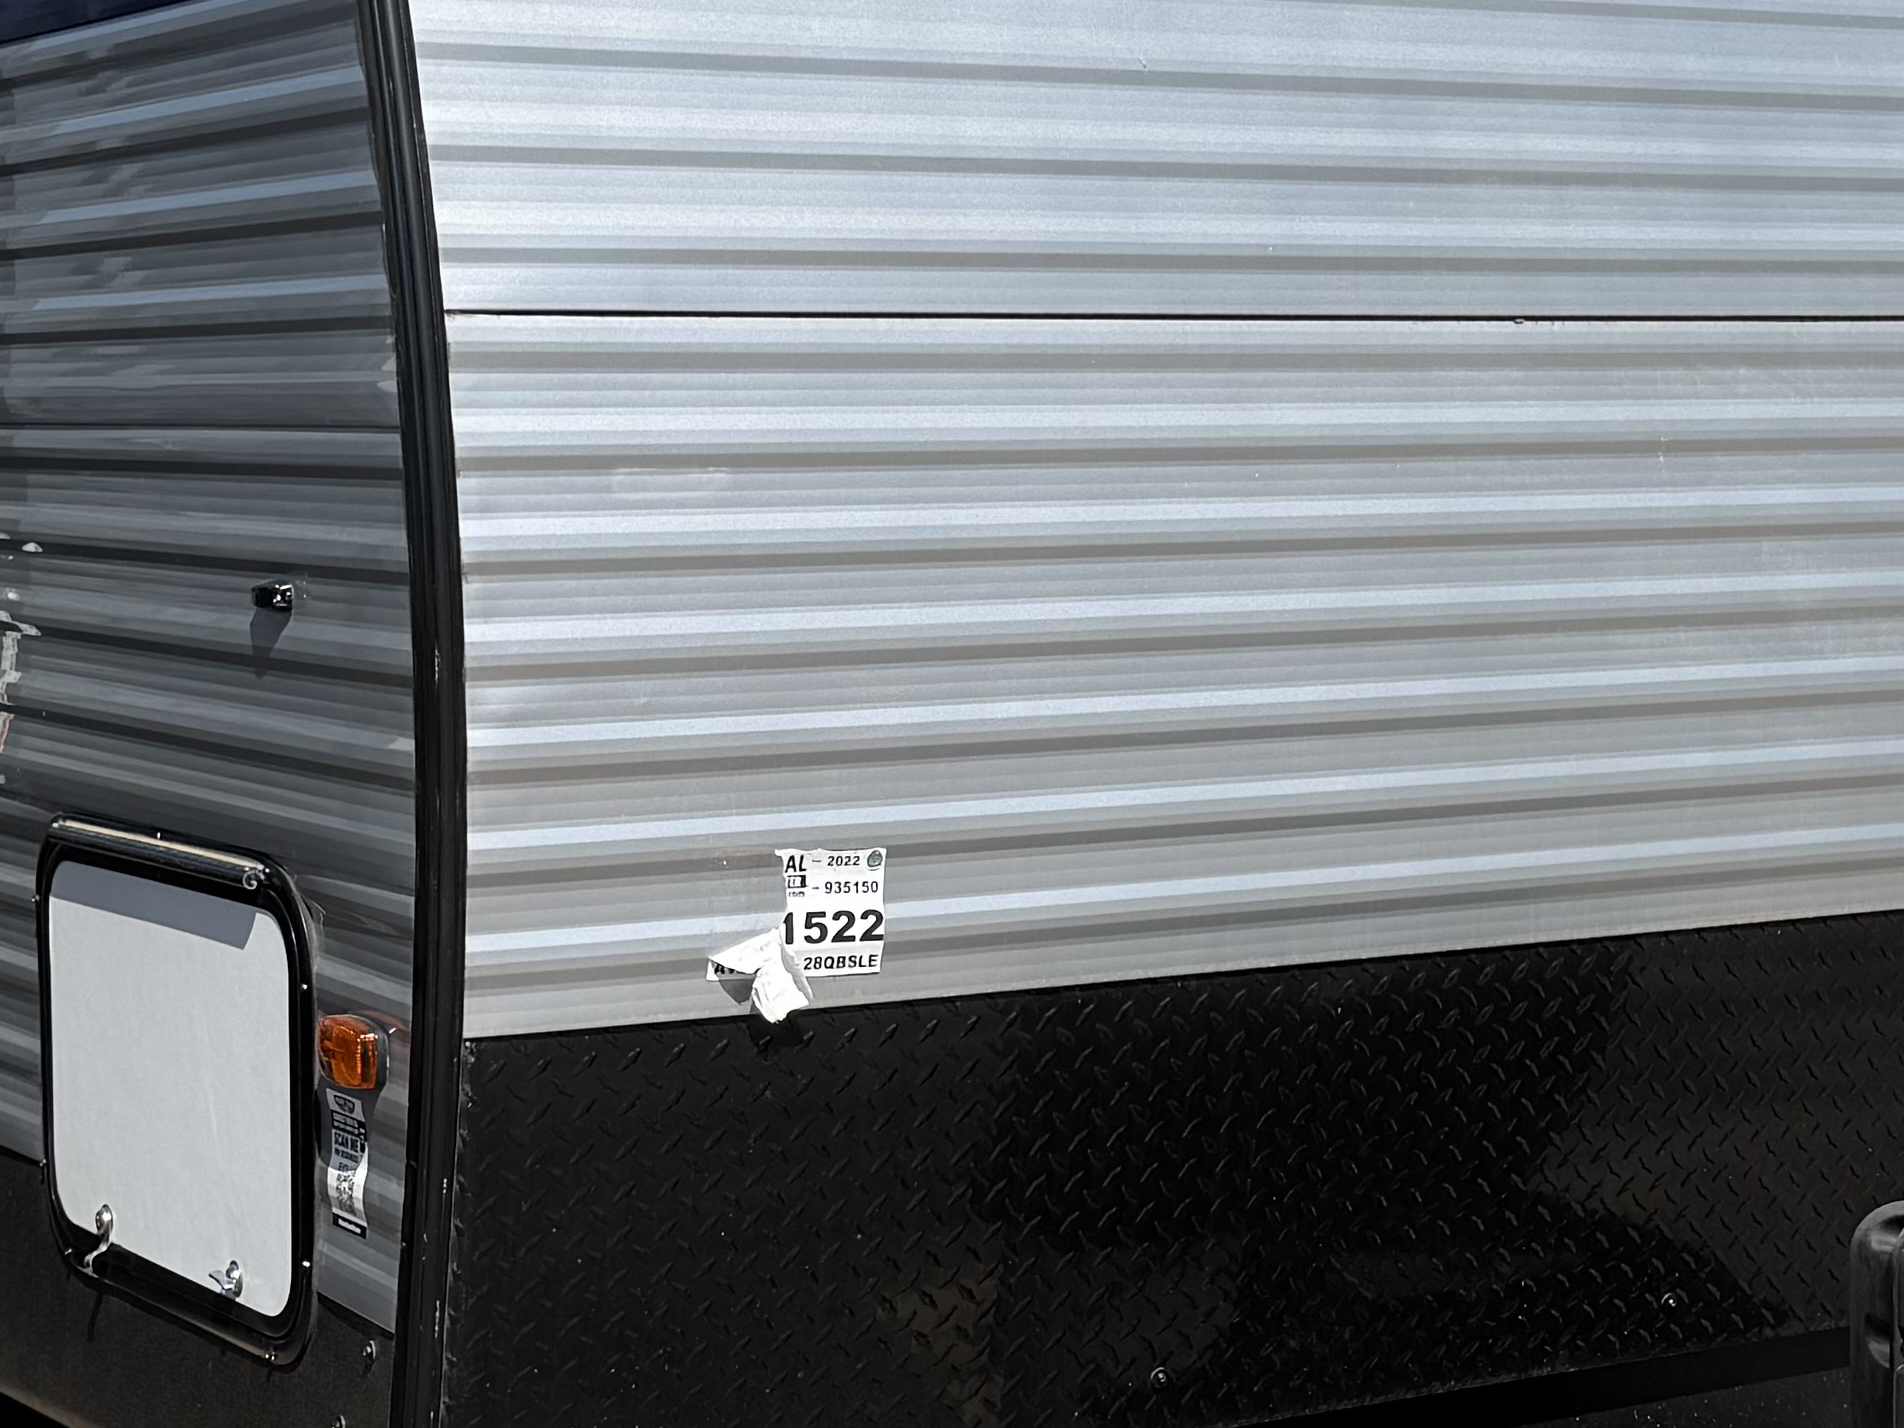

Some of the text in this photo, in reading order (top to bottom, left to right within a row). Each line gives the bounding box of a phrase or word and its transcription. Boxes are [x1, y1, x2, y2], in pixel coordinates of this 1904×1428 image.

[826, 855, 861, 867] 2022
[824, 880, 879, 894] 935150
[782, 909, 885, 945] 1522
[802, 954, 880, 971] 28QBSLE
